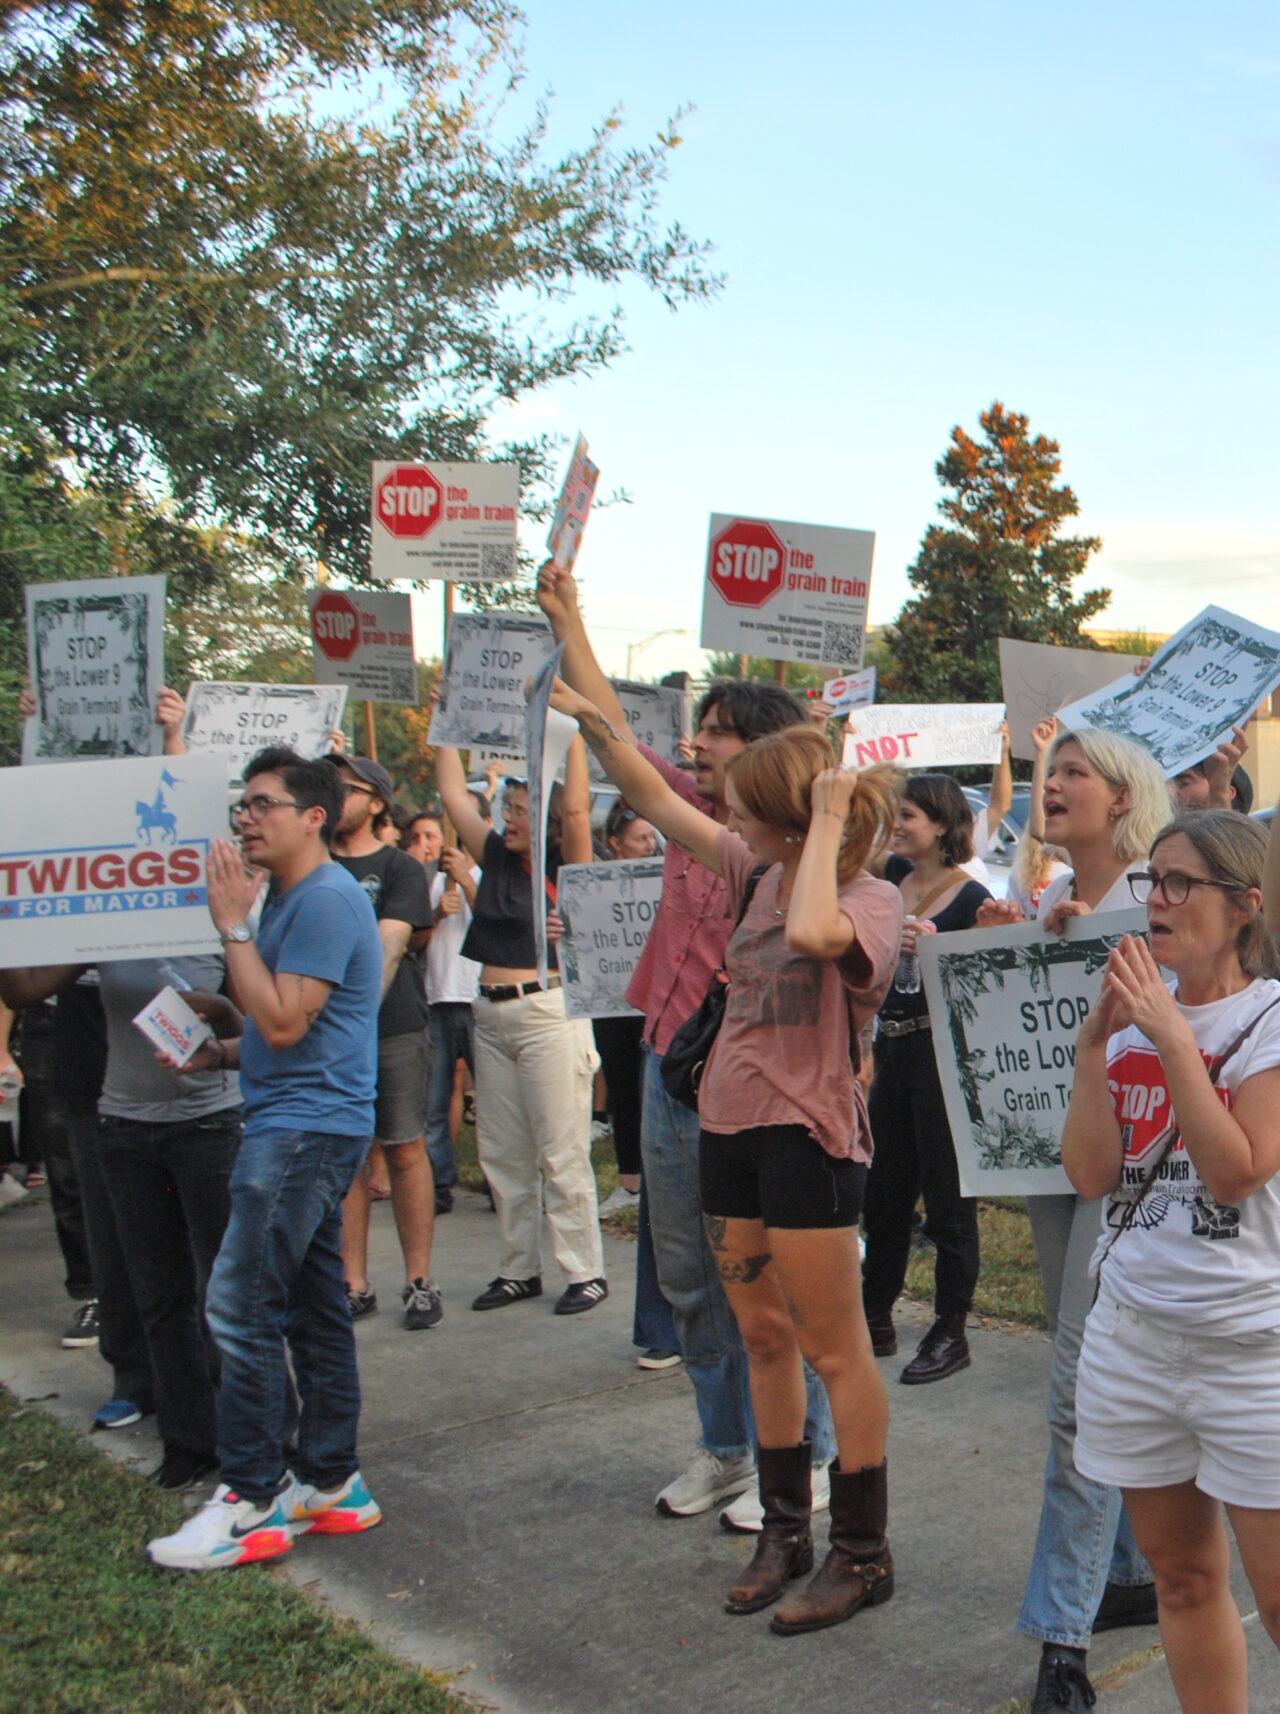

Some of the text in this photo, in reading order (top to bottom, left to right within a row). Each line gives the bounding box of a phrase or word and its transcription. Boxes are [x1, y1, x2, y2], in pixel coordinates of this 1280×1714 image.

[380, 485, 438, 517] STOP
[447, 486, 469, 502] the
[447, 504, 515, 522] grain train
[716, 542, 779, 582] STOP
[790, 549, 814, 569] the
[787, 573, 867, 598] grain train
[316, 611, 355, 640] STOP
[67, 636, 107, 660] STOP
[481, 649, 523, 670] STOP
[54, 662, 121, 687] the Lower 9
[462, 670, 523, 692] the Lower
[1194, 662, 1239, 689] STOP
[81, 695, 122, 715] Terminal
[1161, 674, 1226, 713] the Lower 9
[236, 712, 289, 729] STOP
[210, 728, 299, 746] the Lower 9
[854, 732, 919, 767] NOT
[0, 848, 201, 896] TWIGGS
[18, 891, 178, 917] FOR MAYOR
[593, 930, 618, 949] the
[598, 957, 633, 974] Grain
[1020, 997, 1090, 1033] STOP
[995, 1042, 1030, 1073] the
[1003, 1086, 1052, 1112] Grain
